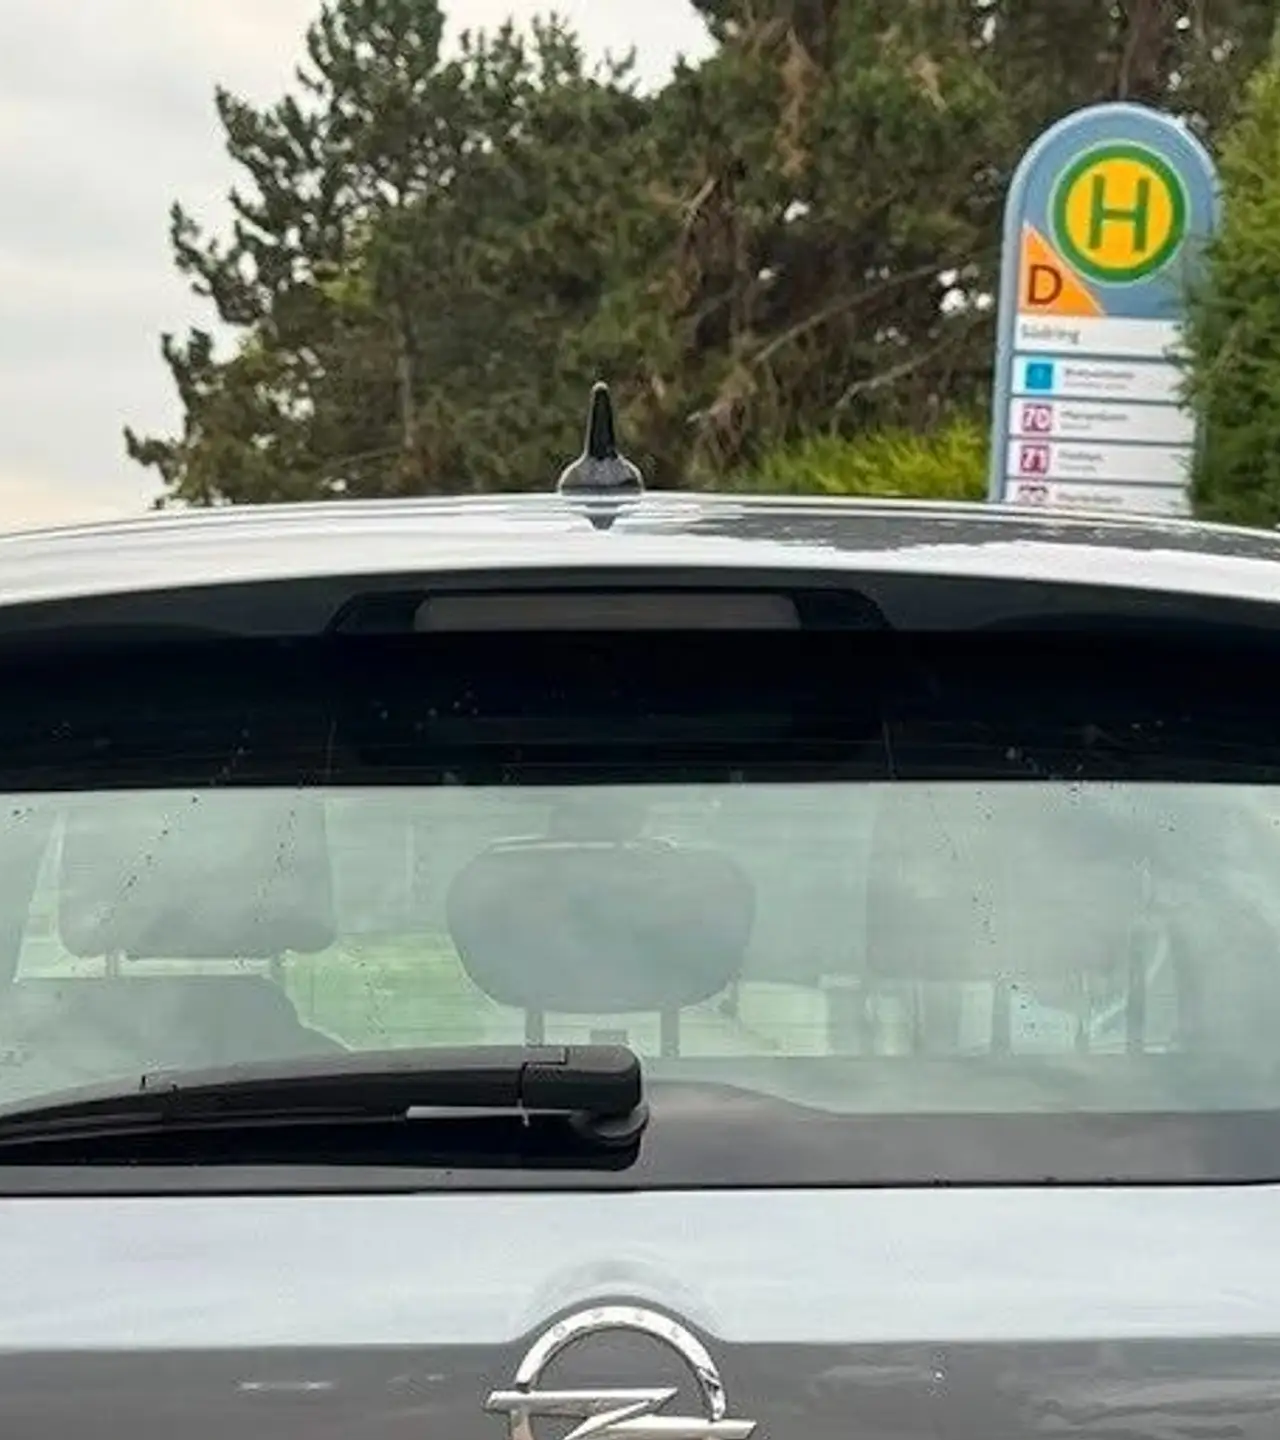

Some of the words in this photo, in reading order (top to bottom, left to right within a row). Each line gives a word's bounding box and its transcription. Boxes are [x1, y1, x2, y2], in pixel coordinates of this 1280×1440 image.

[1088, 173, 1150, 253] H
[1028, 264, 1063, 306] D
[1023, 406, 1051, 431] 70
